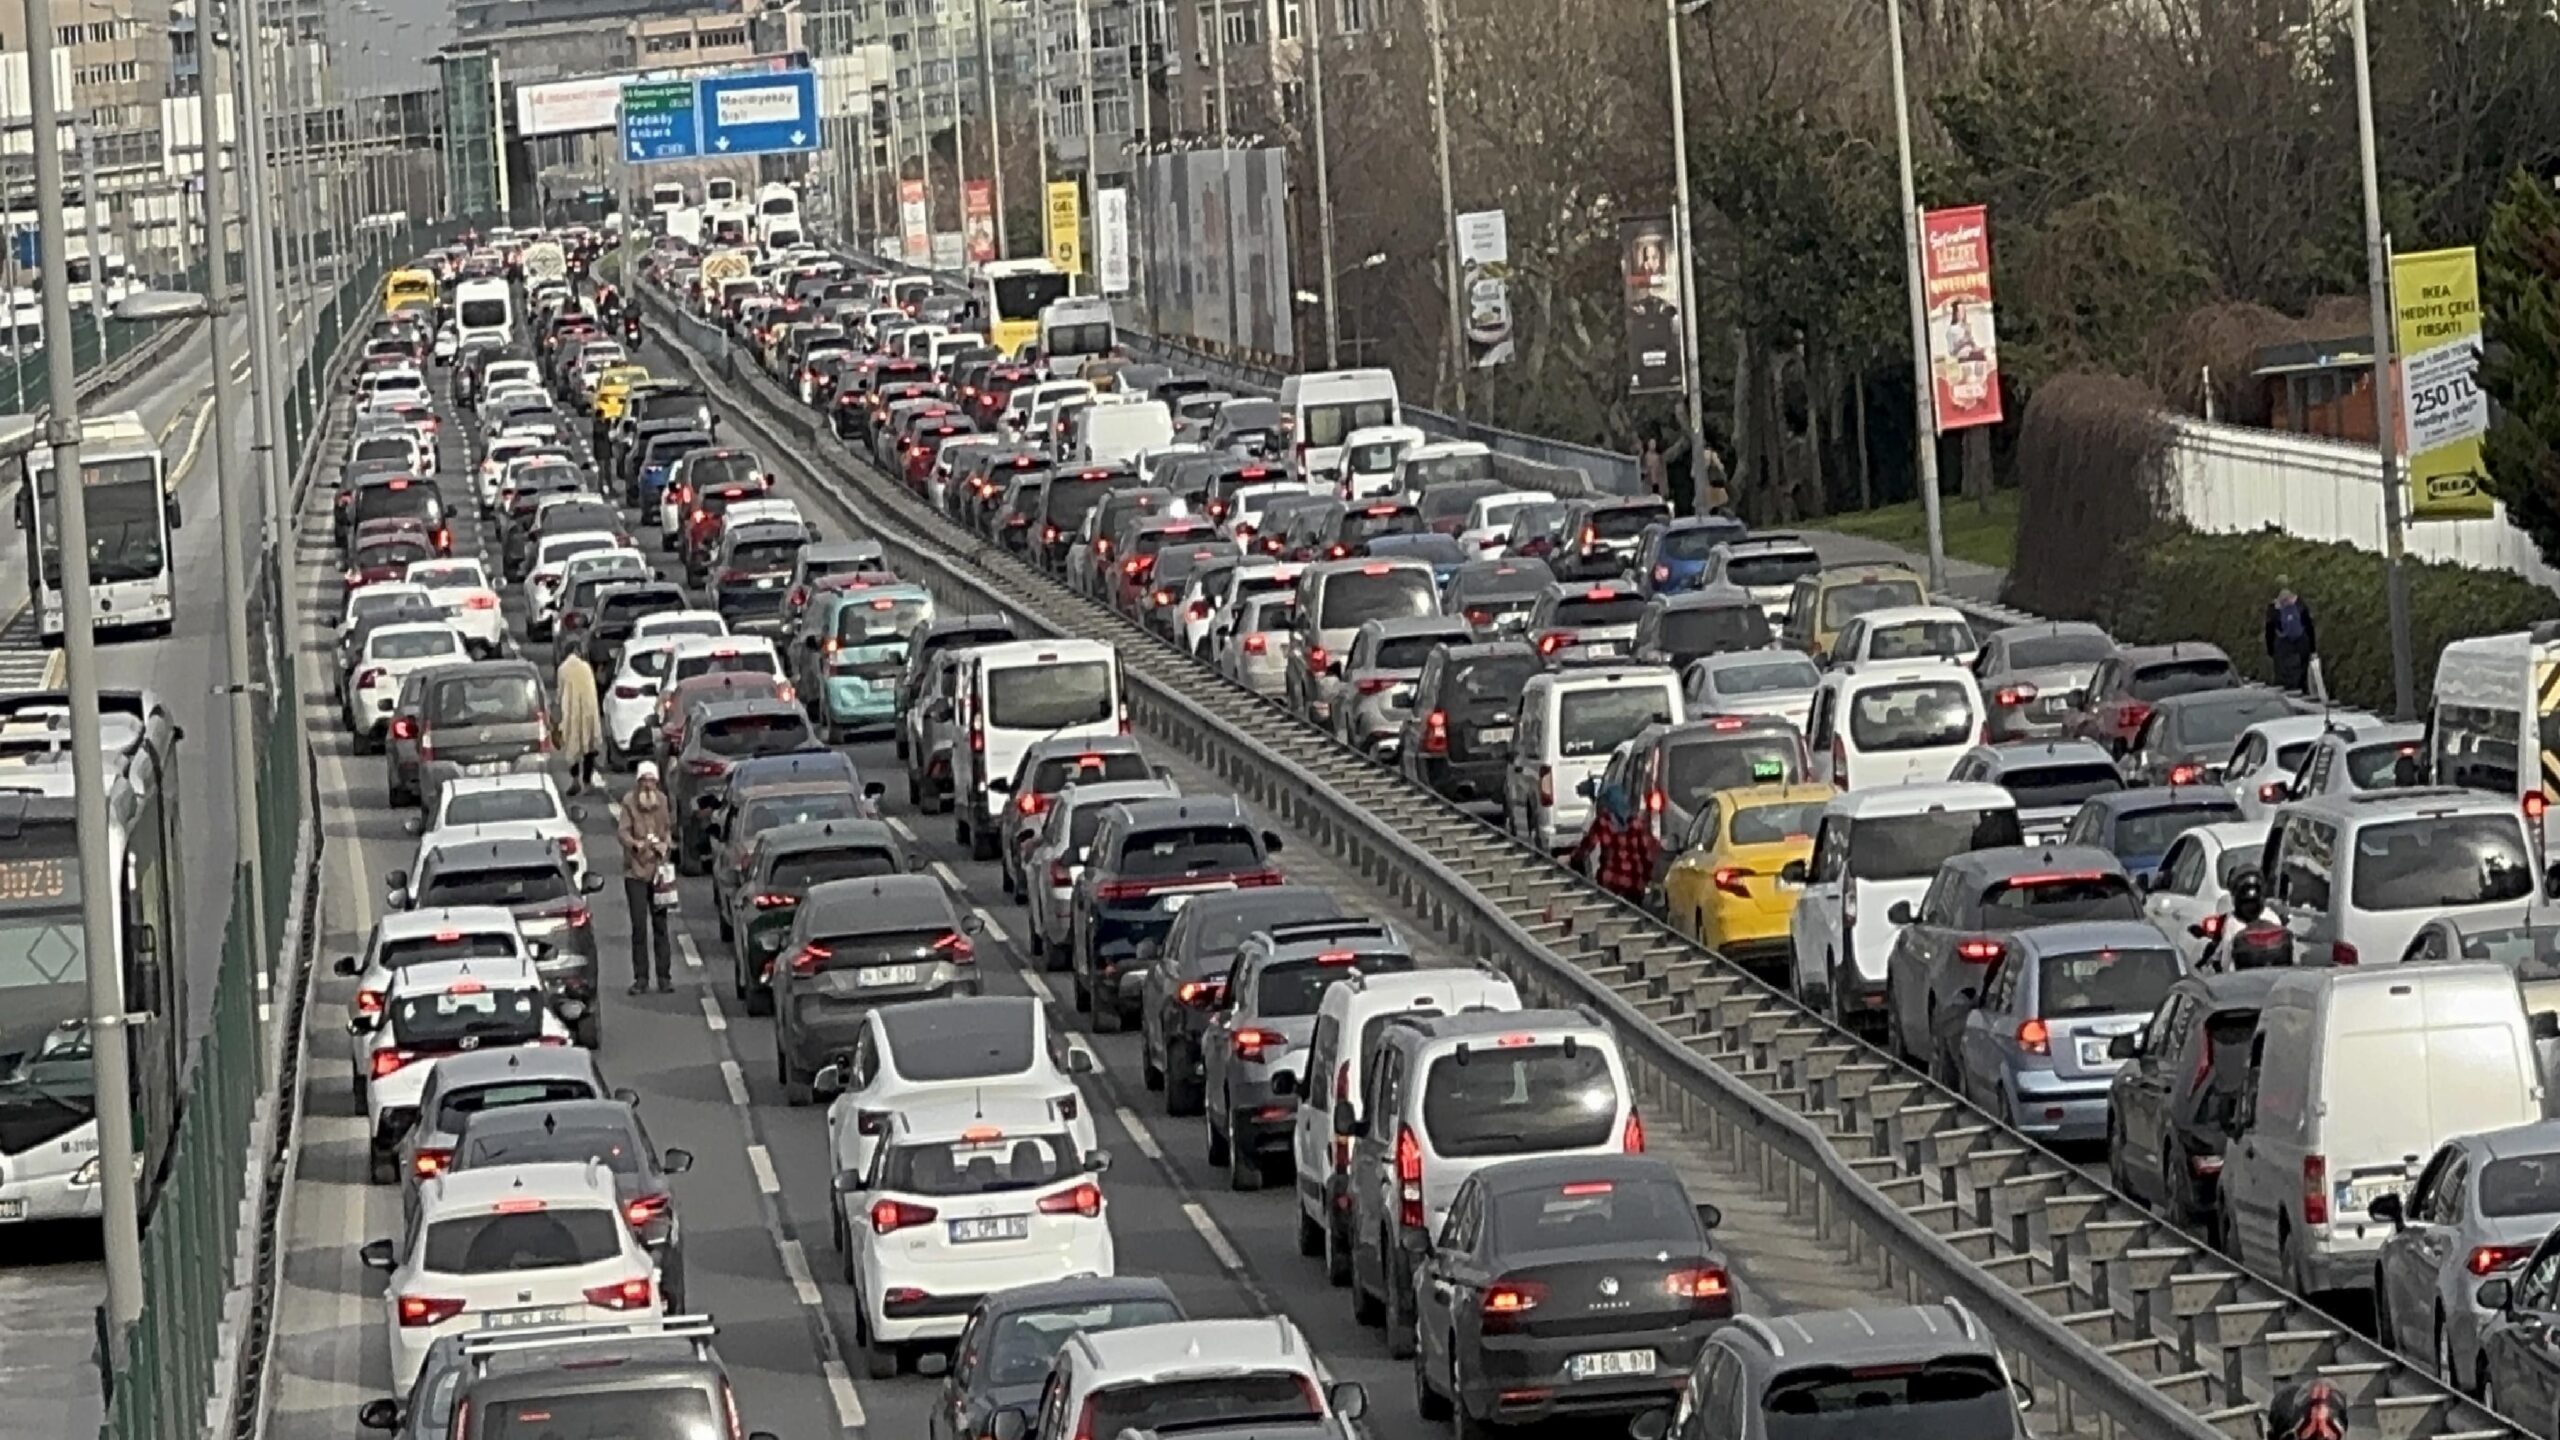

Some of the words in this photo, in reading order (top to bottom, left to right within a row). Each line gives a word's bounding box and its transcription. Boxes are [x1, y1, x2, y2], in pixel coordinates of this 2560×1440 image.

[2422, 284, 2451, 299] IKEA
[2401, 304, 2443, 320] HEDİYE
[2448, 296, 2475, 318] ÇEKİ
[2416, 321, 2462, 338] FIRSATI
[2411, 384, 2449, 415] 250
[2449, 377, 2478, 401] TL
[2432, 479, 2472, 493] IKEA
